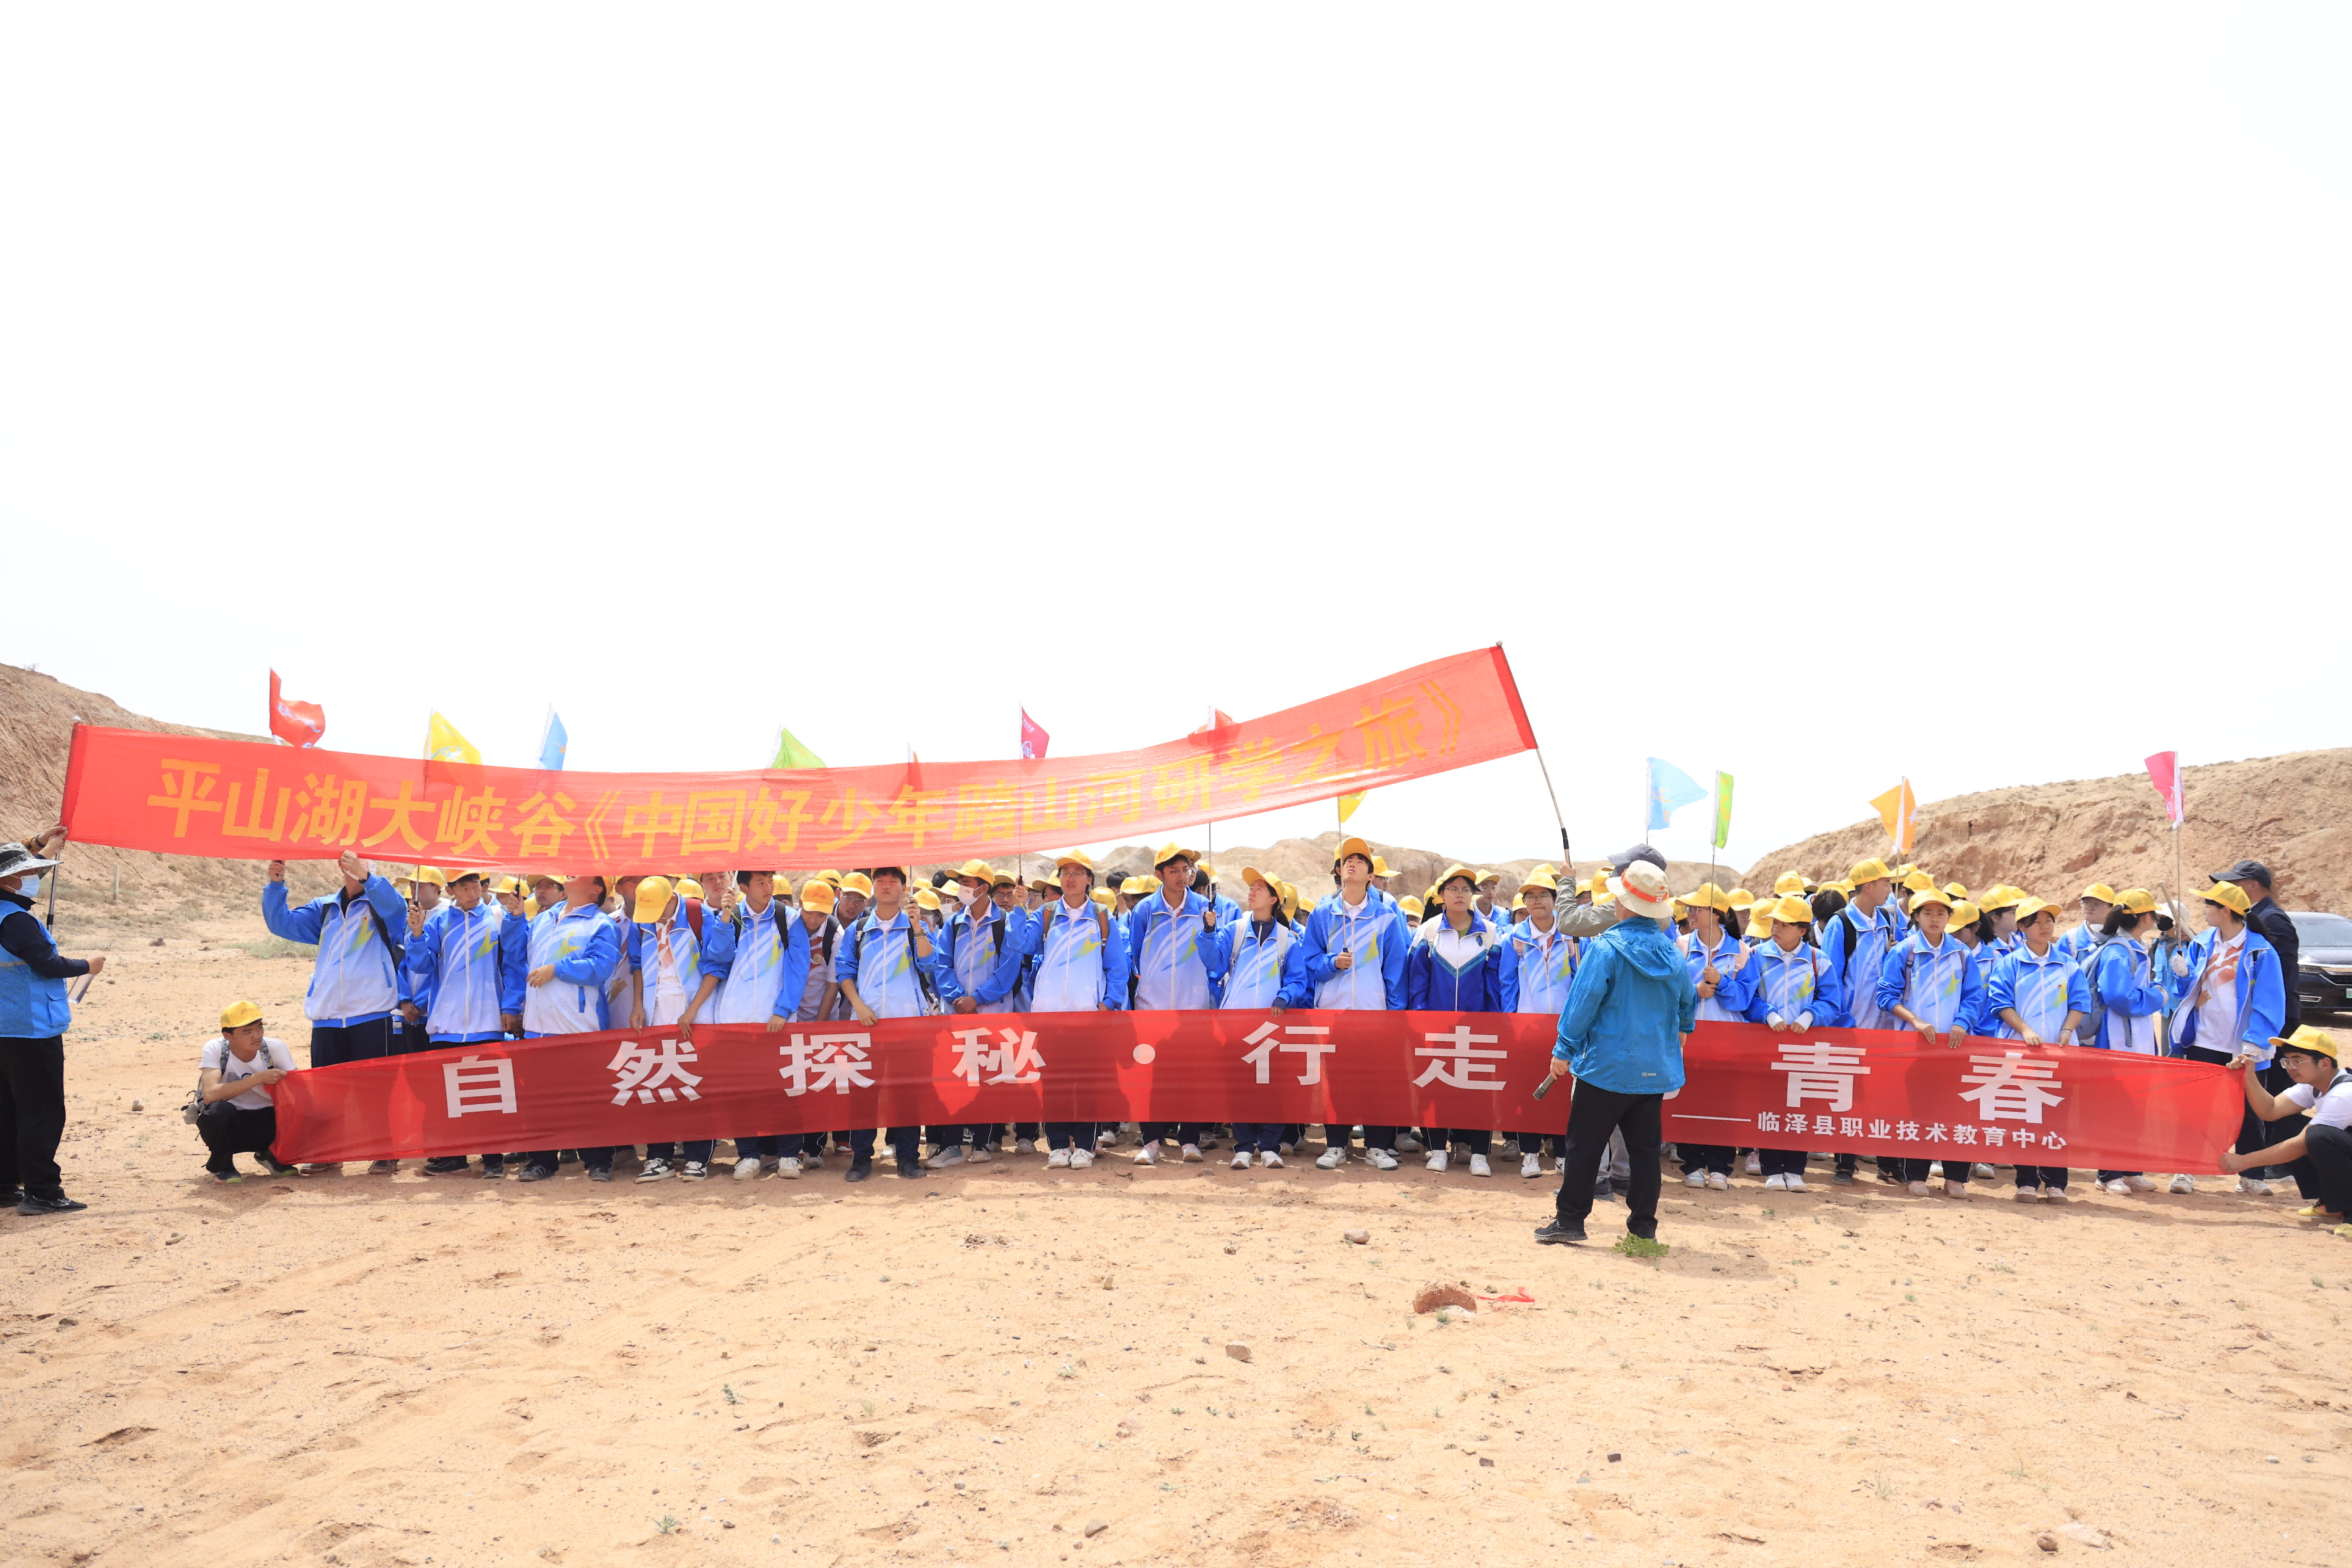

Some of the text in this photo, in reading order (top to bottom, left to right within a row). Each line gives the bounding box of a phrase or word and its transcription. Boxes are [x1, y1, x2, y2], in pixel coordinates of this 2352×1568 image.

[147, 679, 1461, 860] 平山湖大峡谷《中国好少年踏山河研学之旅》
[443, 1021, 2065, 1124] 自然探秘·行走青春
